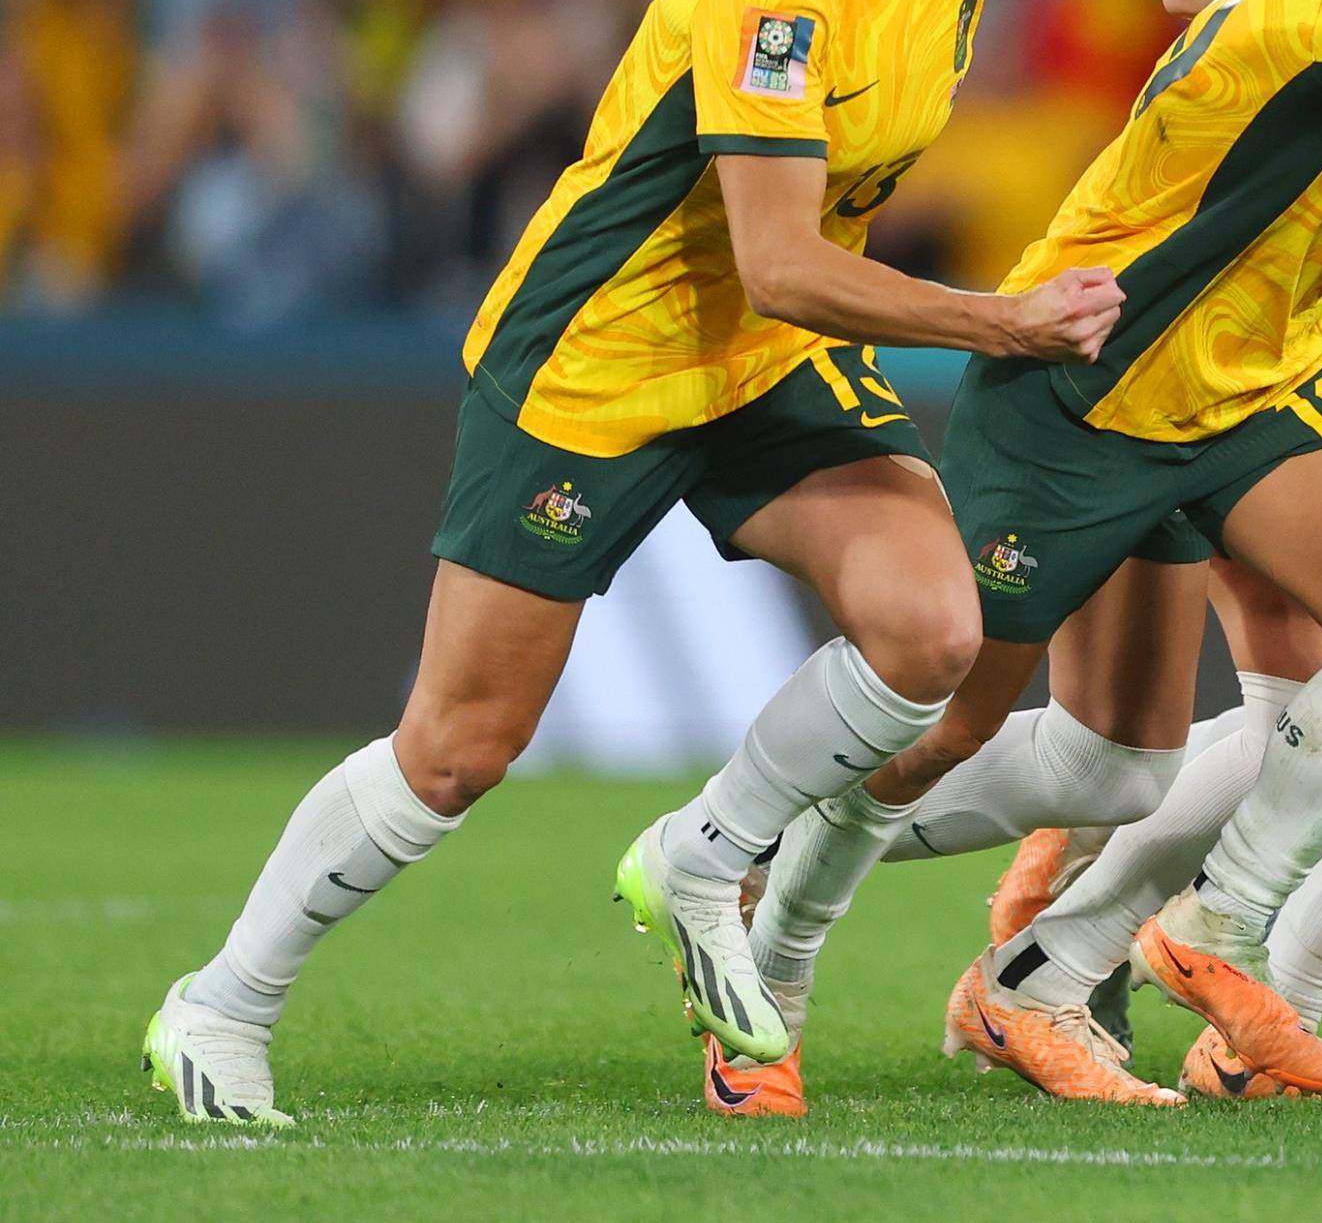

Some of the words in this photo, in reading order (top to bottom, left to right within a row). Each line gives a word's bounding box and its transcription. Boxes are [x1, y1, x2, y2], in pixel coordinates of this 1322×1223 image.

[527, 512, 578, 536] AUSTRALIA
[974, 563, 1025, 585] AUSTRALIA
[1276, 706, 1304, 748] US
